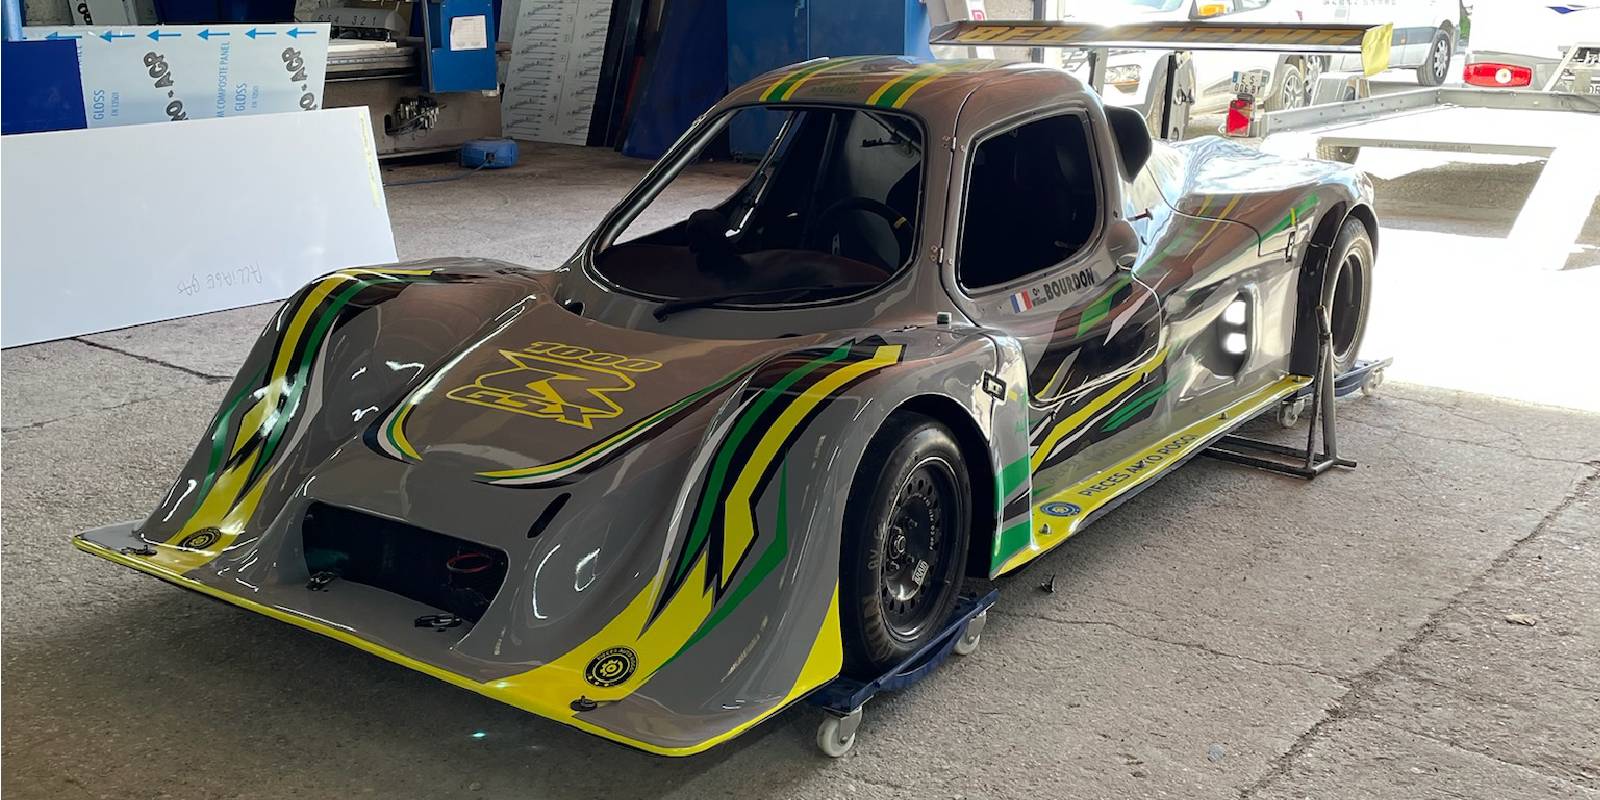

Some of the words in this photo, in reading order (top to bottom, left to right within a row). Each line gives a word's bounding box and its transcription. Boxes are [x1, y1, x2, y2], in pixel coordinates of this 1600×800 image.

[220, 41, 230, 65] PANEL
[217, 66, 229, 110] COMPOSITE
[234, 82, 247, 112] GLOSS
[93, 89, 105, 120] GLOSS
[1043, 267, 1095, 301] BOURDON
[523, 341, 663, 372] 1000
[1079, 472, 1131, 497] PIECES
